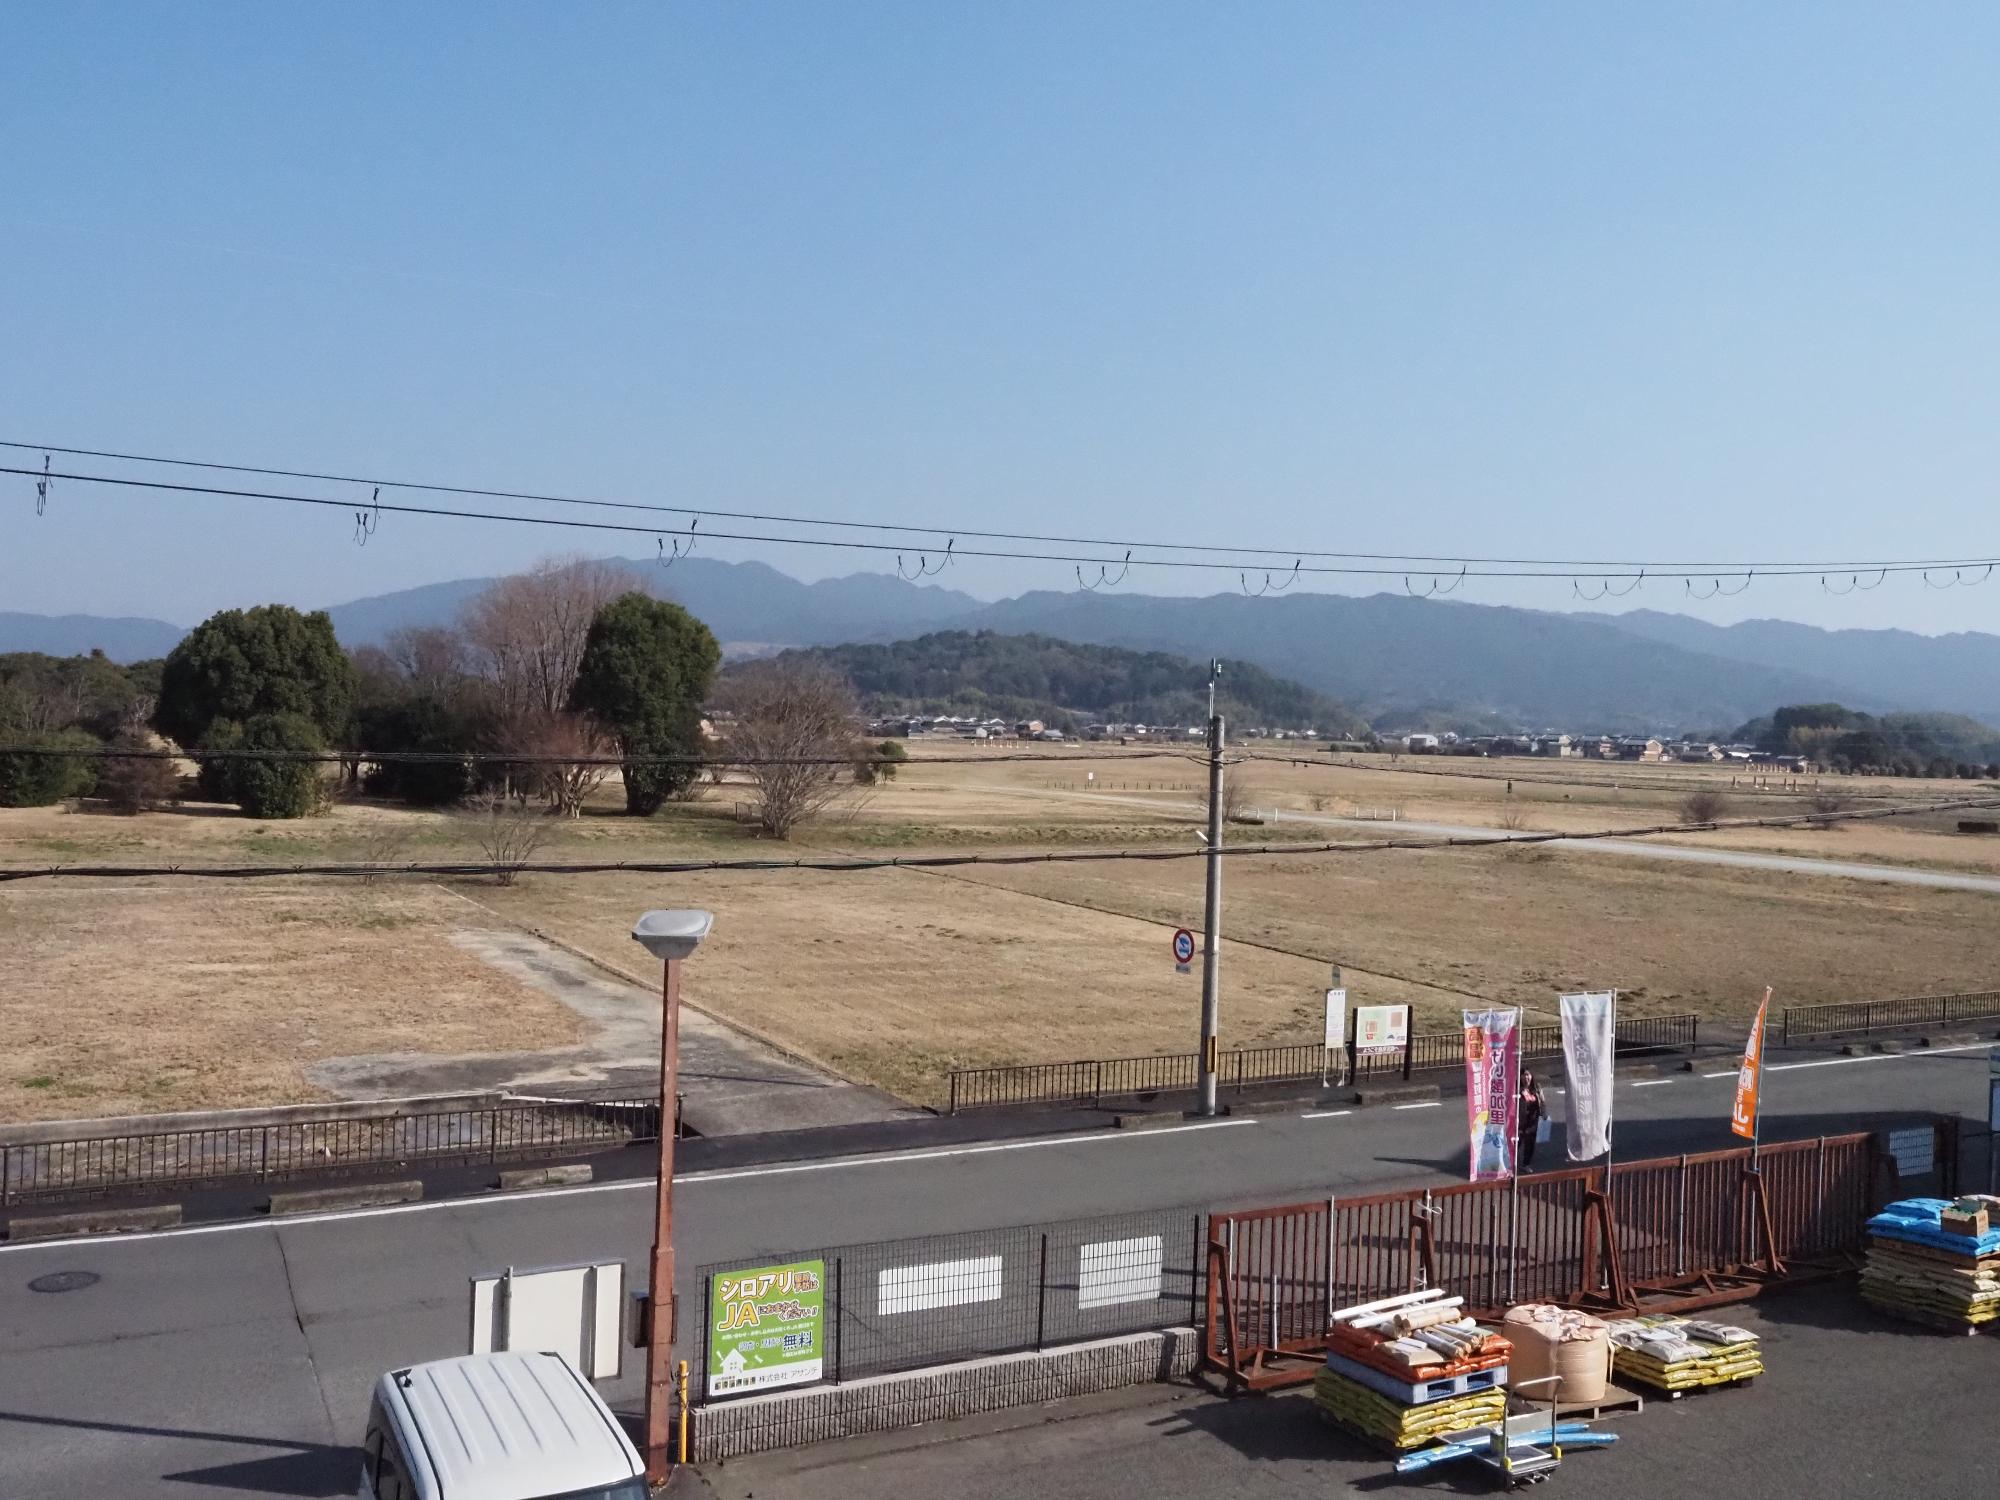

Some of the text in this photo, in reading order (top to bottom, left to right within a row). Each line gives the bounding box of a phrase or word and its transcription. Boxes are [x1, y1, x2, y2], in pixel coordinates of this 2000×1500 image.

[720, 1271, 793, 1302] シロアリ
[718, 1301, 760, 1330] JA
[783, 1331, 813, 1350] 無料
[759, 1373, 788, 1384] 株式会社
